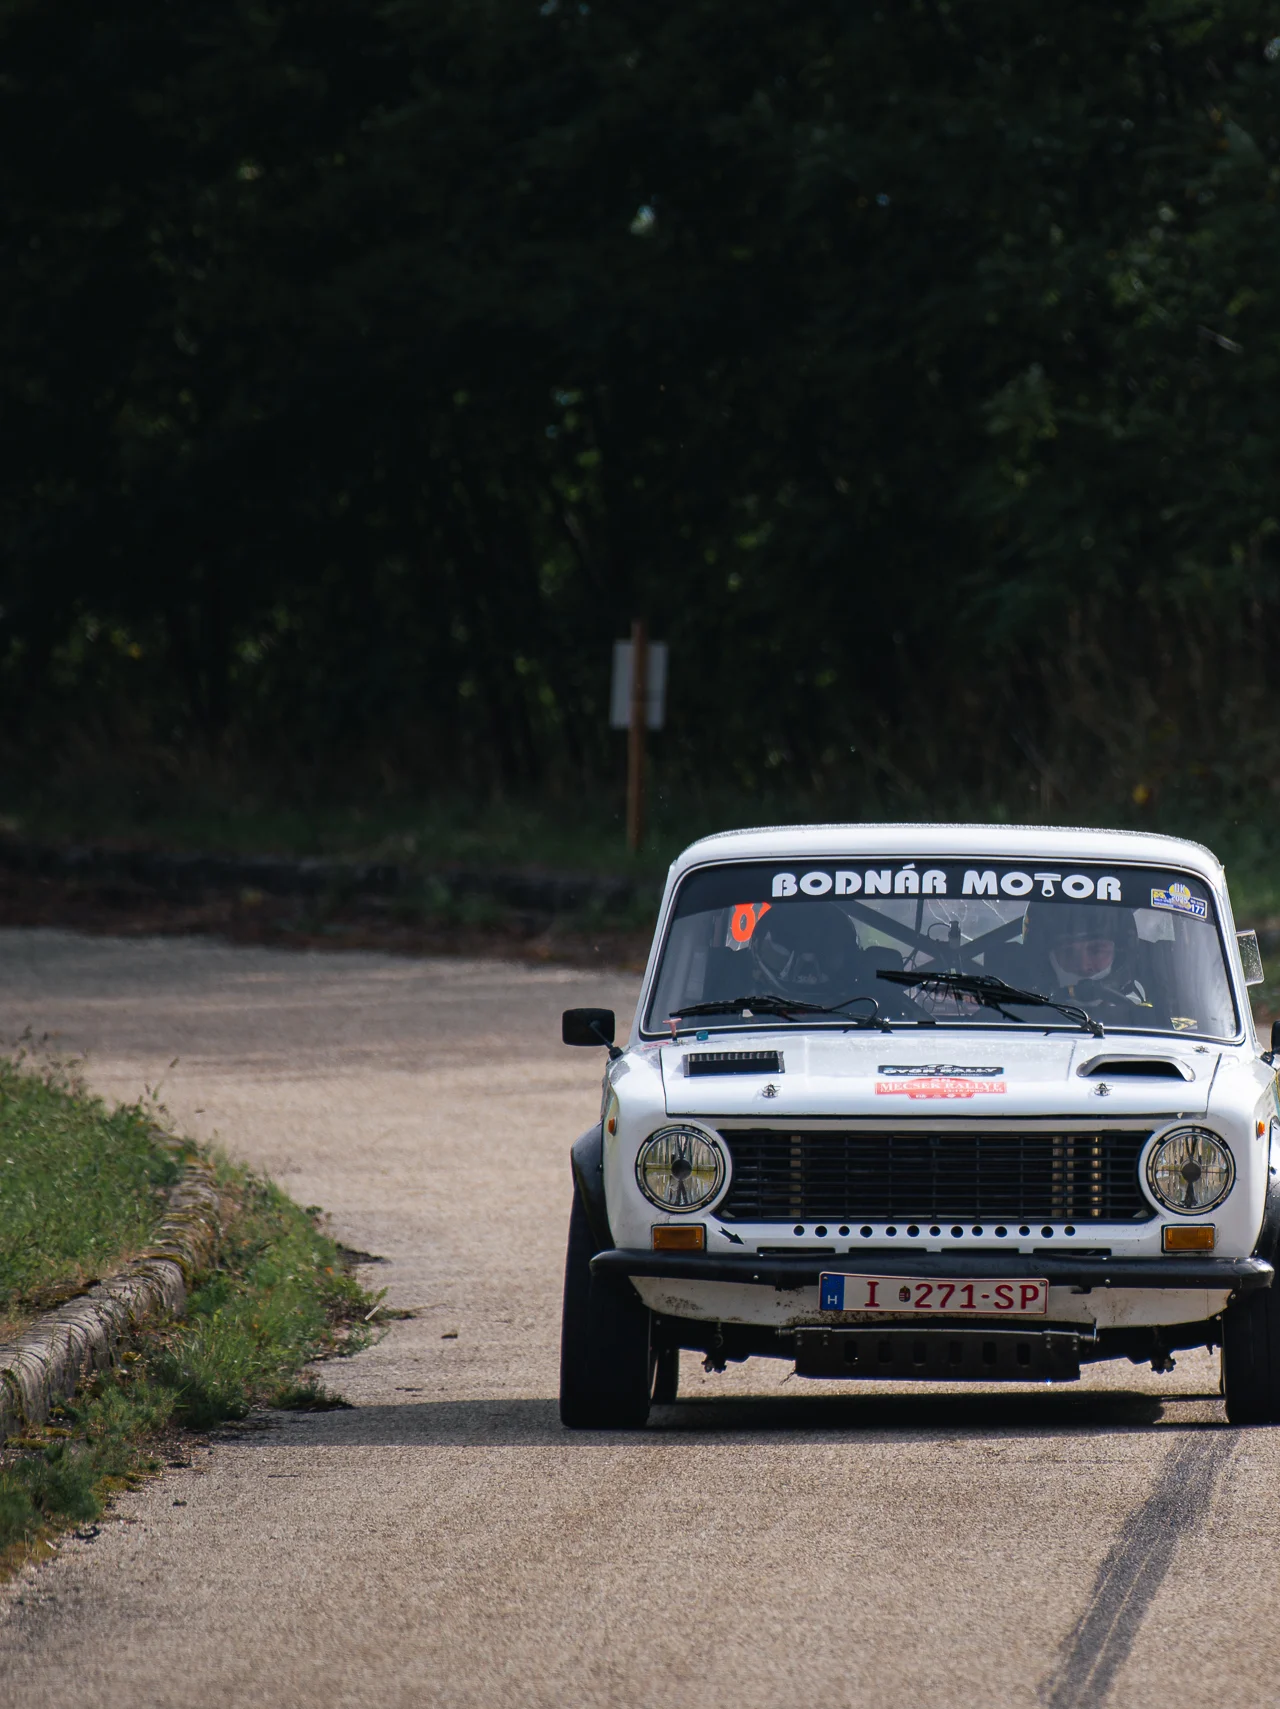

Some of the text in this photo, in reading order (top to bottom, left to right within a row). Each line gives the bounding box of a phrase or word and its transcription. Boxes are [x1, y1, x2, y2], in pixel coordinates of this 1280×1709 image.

[772, 863, 1122, 901] BODNÁR MOTOR
[1191, 904, 1205, 915] 177
[880, 1082, 941, 1091] MECSEK
[945, 1082, 1002, 1090] RALLYE
[827, 1294, 838, 1305] H
[914, 1283, 1039, 1310] 271-SP
